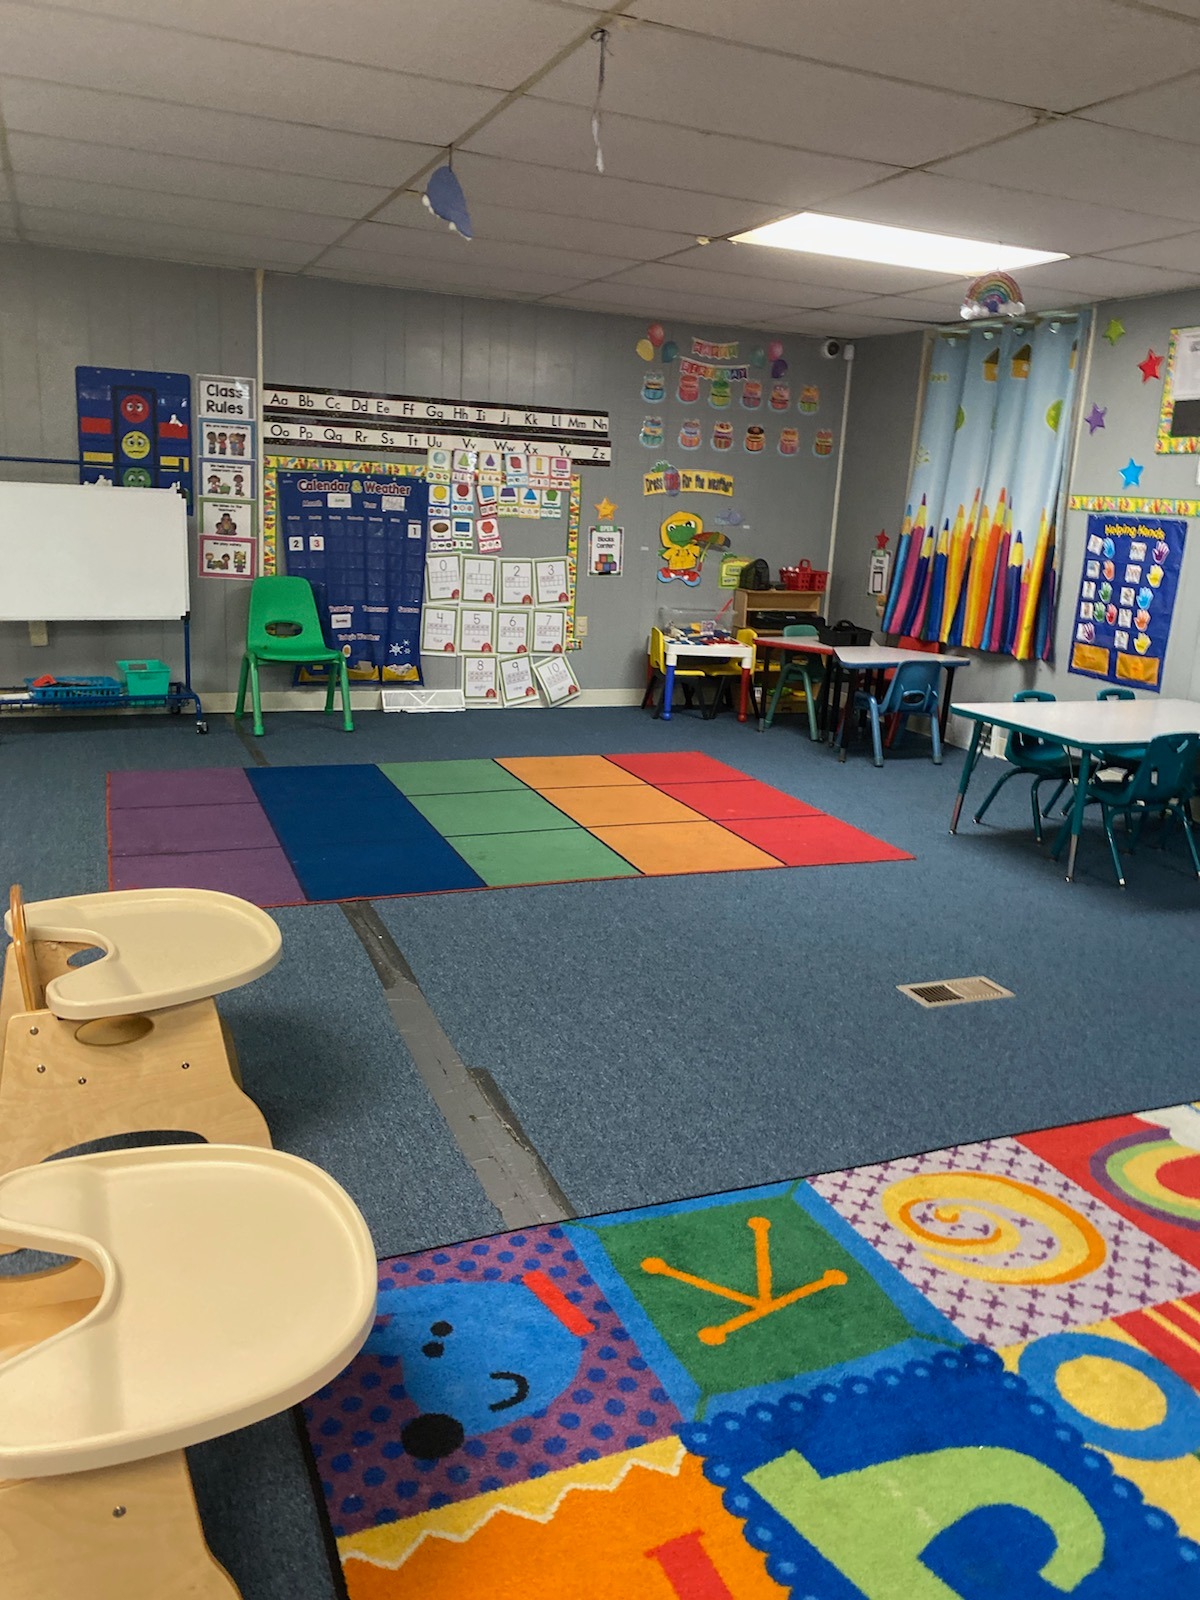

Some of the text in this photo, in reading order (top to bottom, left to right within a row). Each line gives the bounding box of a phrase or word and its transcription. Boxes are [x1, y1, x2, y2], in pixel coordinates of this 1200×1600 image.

[206, 384, 243, 398] Class
[206, 400, 243, 415] Rules
[270, 394, 607, 430] Aa Bb Cc Dd Ee Ff Gg Hh Ii Jj Kk Ll Mm Nn
[270, 424, 290, 437] Oo
[299, 426, 313, 440] Pp
[324, 429, 342, 443] Qq
[355, 431, 368, 443] Rr
[382, 433, 394, 445] Ss
[408, 435, 418, 446] Tt
[427, 436, 442, 448] Uu
[462, 438, 476, 449] Vv
[494, 441, 515, 451] Ww
[524, 443, 538, 454] Xx
[592, 448, 605, 460] Zz
[298, 480, 411, 496] Calendar & Weather
[646, 478, 663, 492] Dress
[708, 478, 732, 492] weather
[1105, 524, 1166, 541] Helping Hands
[440, 560, 447, 571] 0
[514, 566, 521, 576] 2
[548, 565, 554, 575] 3
[437, 613, 444, 623] 4
[474, 614, 480, 624] 5
[510, 616, 516, 626] 6
[546, 615, 552, 625] 7
[477, 660, 484, 671] 8
[512, 662, 519, 672] 9
[548, 663, 560, 676] 10
